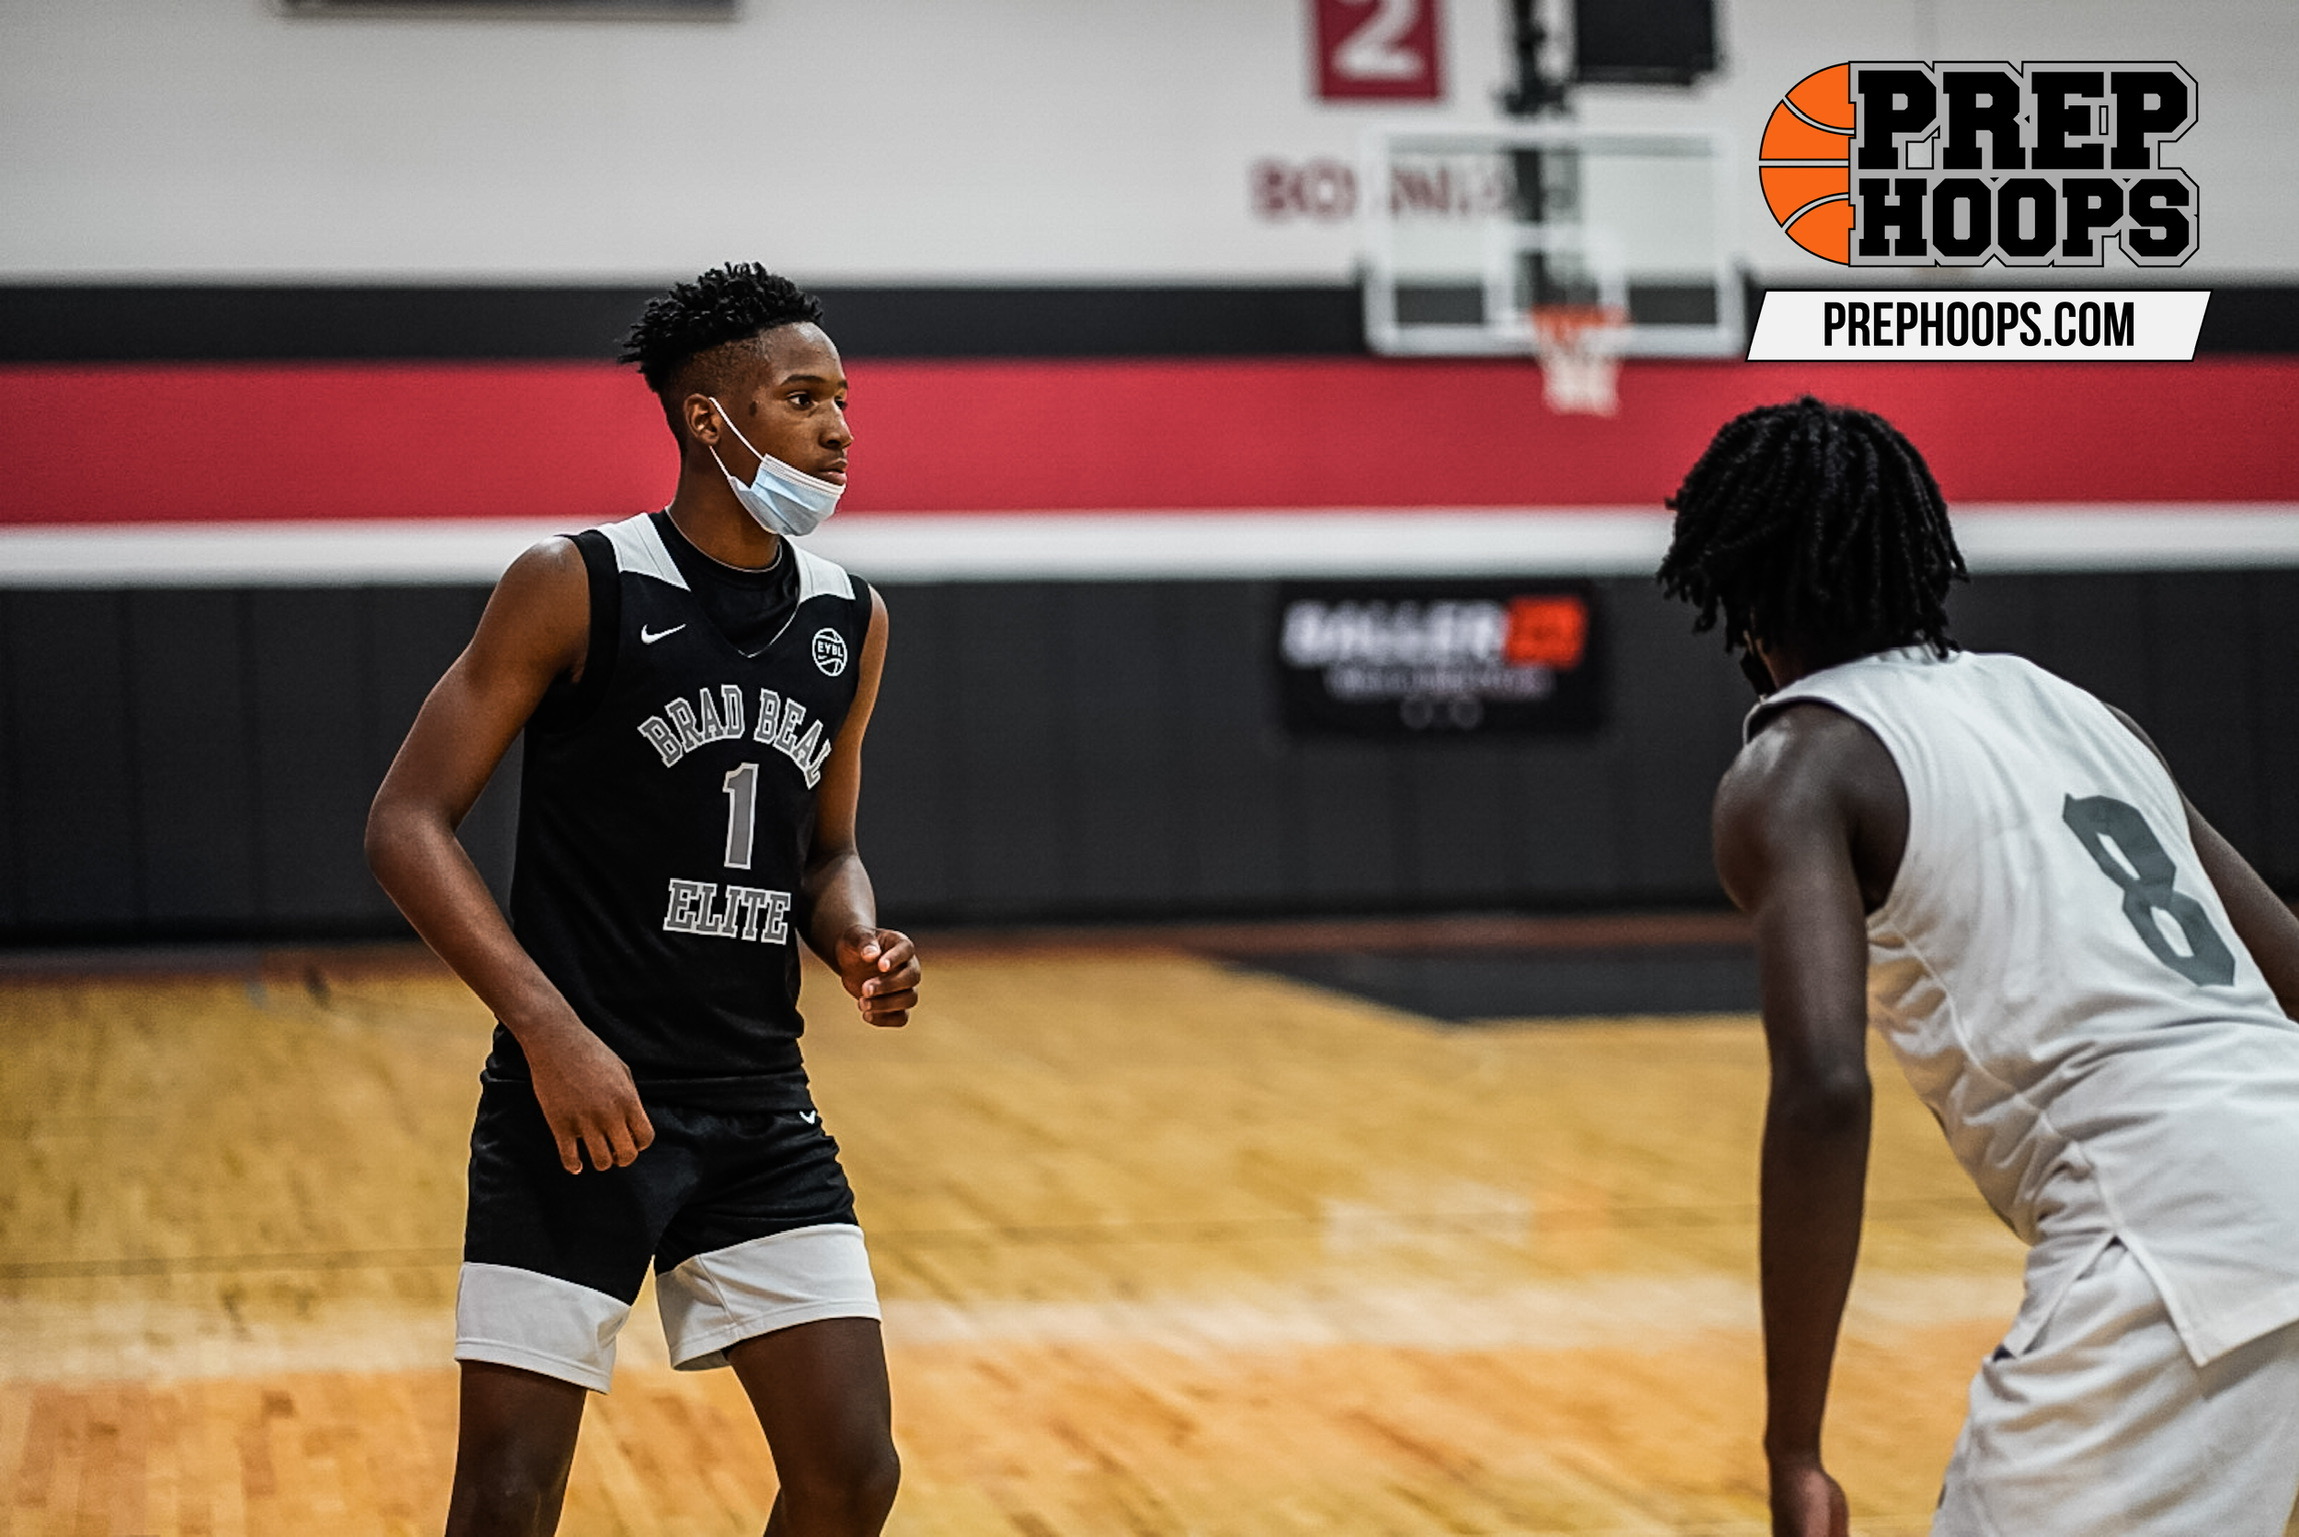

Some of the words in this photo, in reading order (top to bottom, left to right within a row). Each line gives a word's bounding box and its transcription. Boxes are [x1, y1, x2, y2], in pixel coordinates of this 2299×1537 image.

[1330, 0, 1426, 82] 2
[817, 640, 844, 658] EYBL
[637, 684, 745, 769] BRAD
[722, 762, 759, 870] 1
[663, 878, 791, 945] ELITE
[2062, 792, 2236, 986] 8
